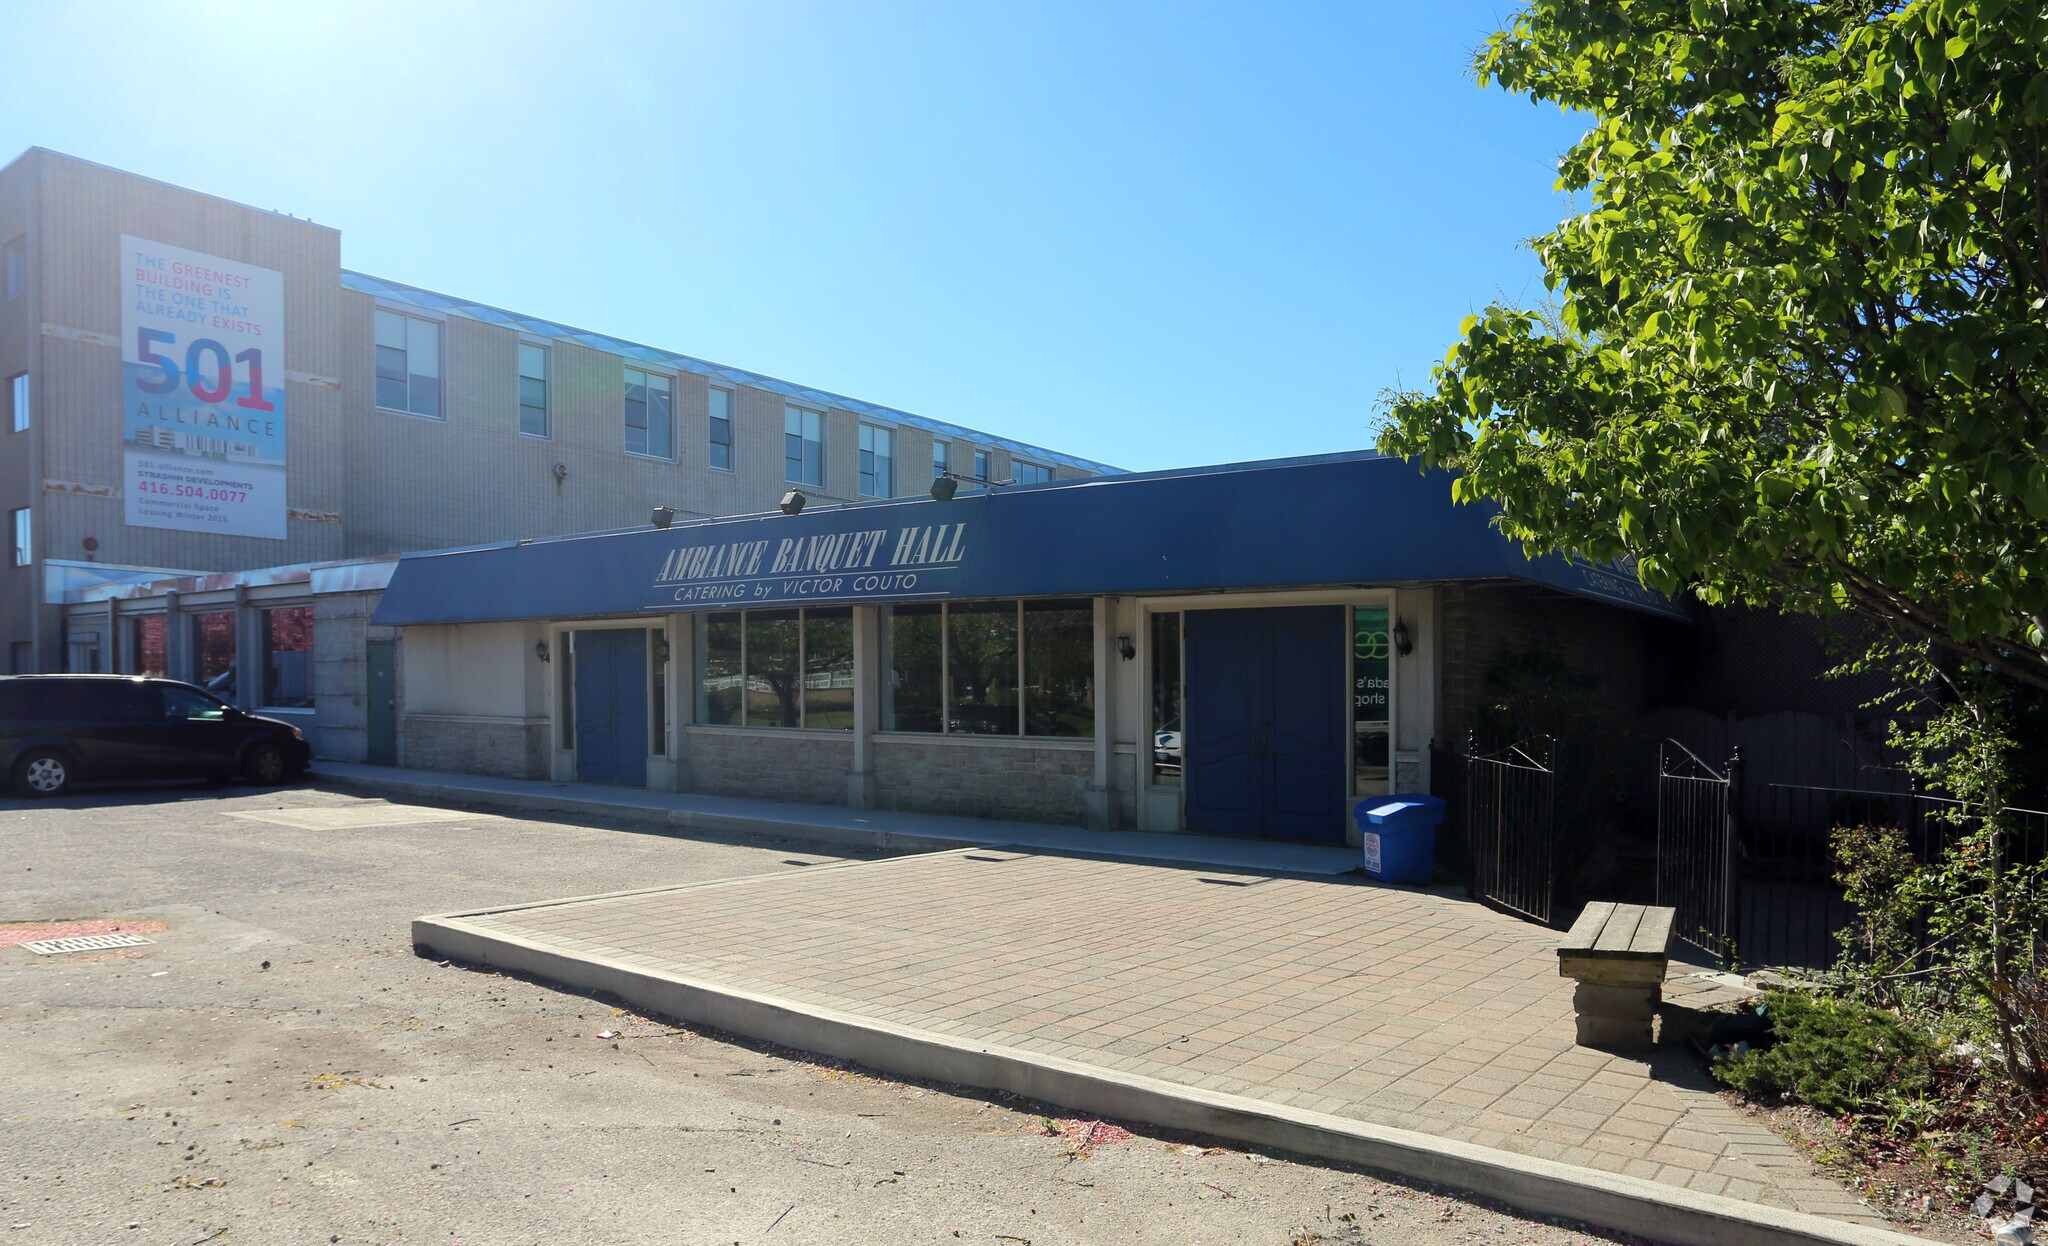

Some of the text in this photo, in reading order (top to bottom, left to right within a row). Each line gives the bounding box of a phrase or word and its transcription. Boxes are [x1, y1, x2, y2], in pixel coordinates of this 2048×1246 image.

[136, 253, 250, 289] THE GREENEST
[136, 268, 232, 300] BUILDING IS
[136, 284, 249, 319] THE ONE THAT
[136, 301, 261, 336] ALREADY EXISTS
[136, 327, 274, 412] 501
[137, 403, 274, 437] ALLIANCE
[138, 460, 213, 475] 501-alliance.com
[138, 471, 254, 490] STRASHIN DEVELOPMENTS
[138, 481, 247, 503] 416.504.0077
[139, 498, 219, 512] Commercial Space
[139, 508, 228, 523] Leasing Winter 2015
[656, 523, 967, 582] AMBIANCE BANQUET HALL
[674, 574, 917, 601] CATERING by VICTOR COUTO
